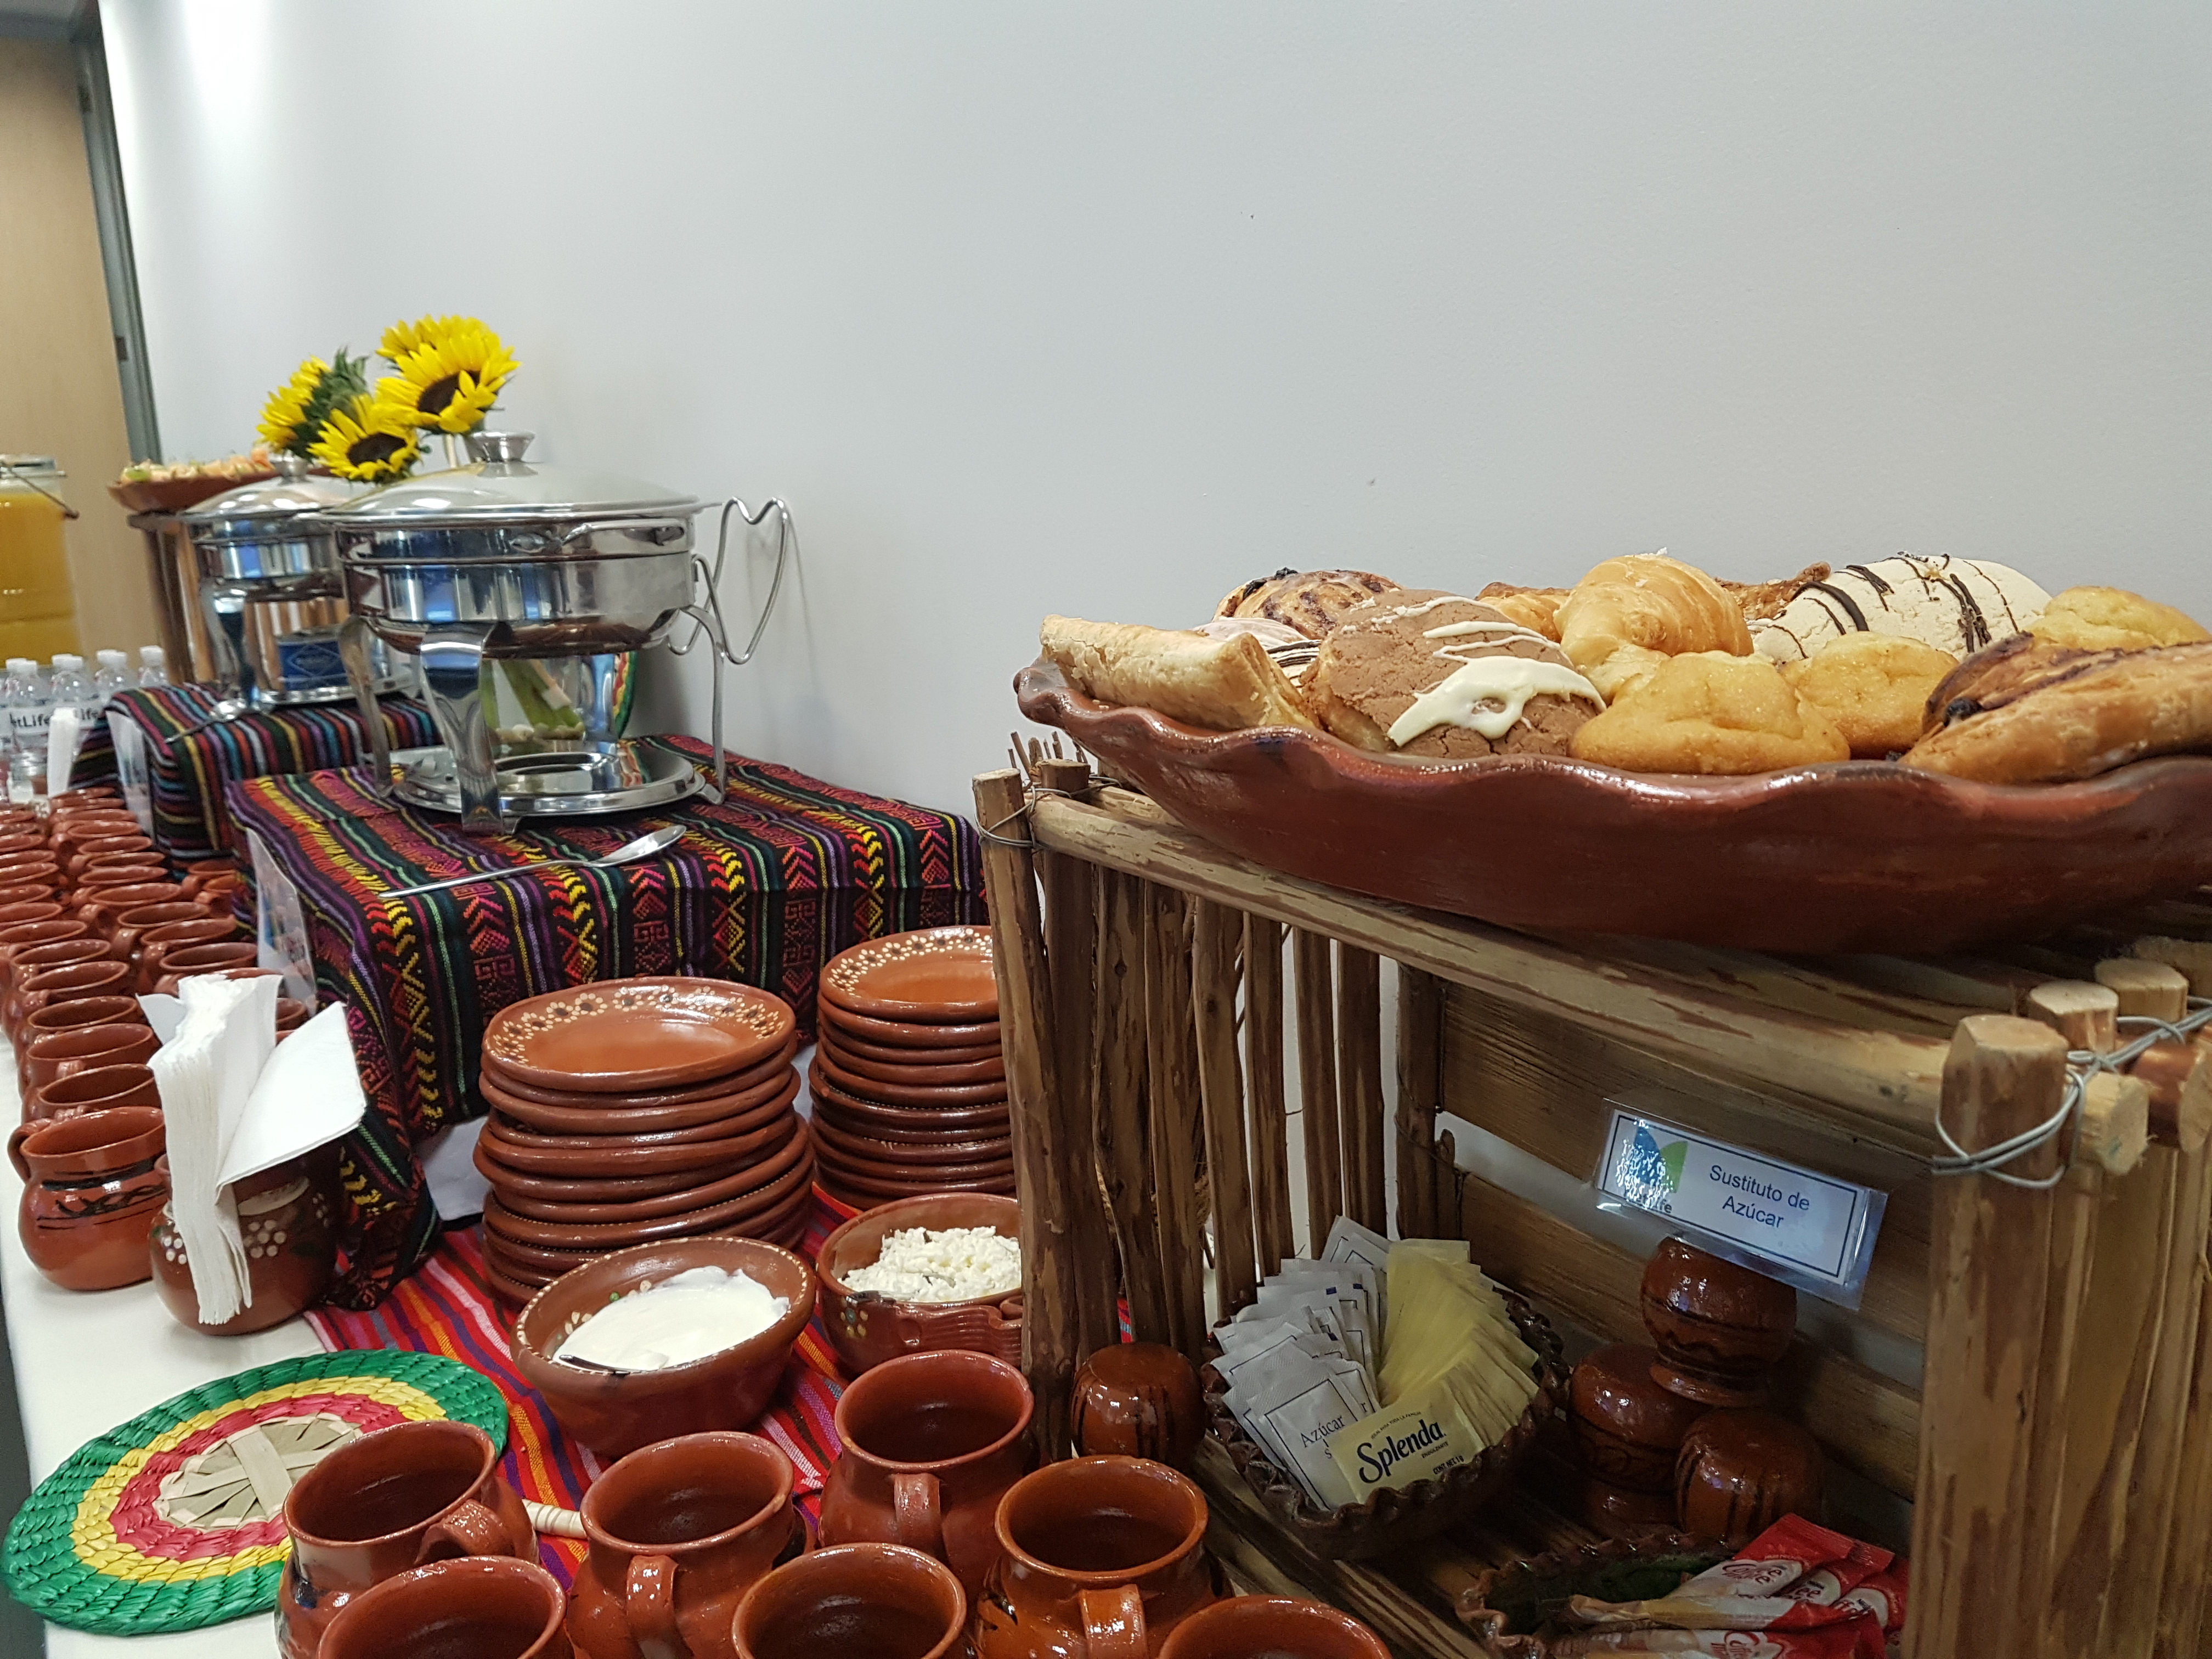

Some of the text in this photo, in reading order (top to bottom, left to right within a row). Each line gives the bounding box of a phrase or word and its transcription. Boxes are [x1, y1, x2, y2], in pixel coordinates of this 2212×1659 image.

[1709, 1165, 1810, 1210] Sustituto de
[1722, 1195, 1784, 1228] Azúcar
[1301, 1415, 1345, 1448] Azúcar
[1357, 1419, 1445, 1483] Splenda
